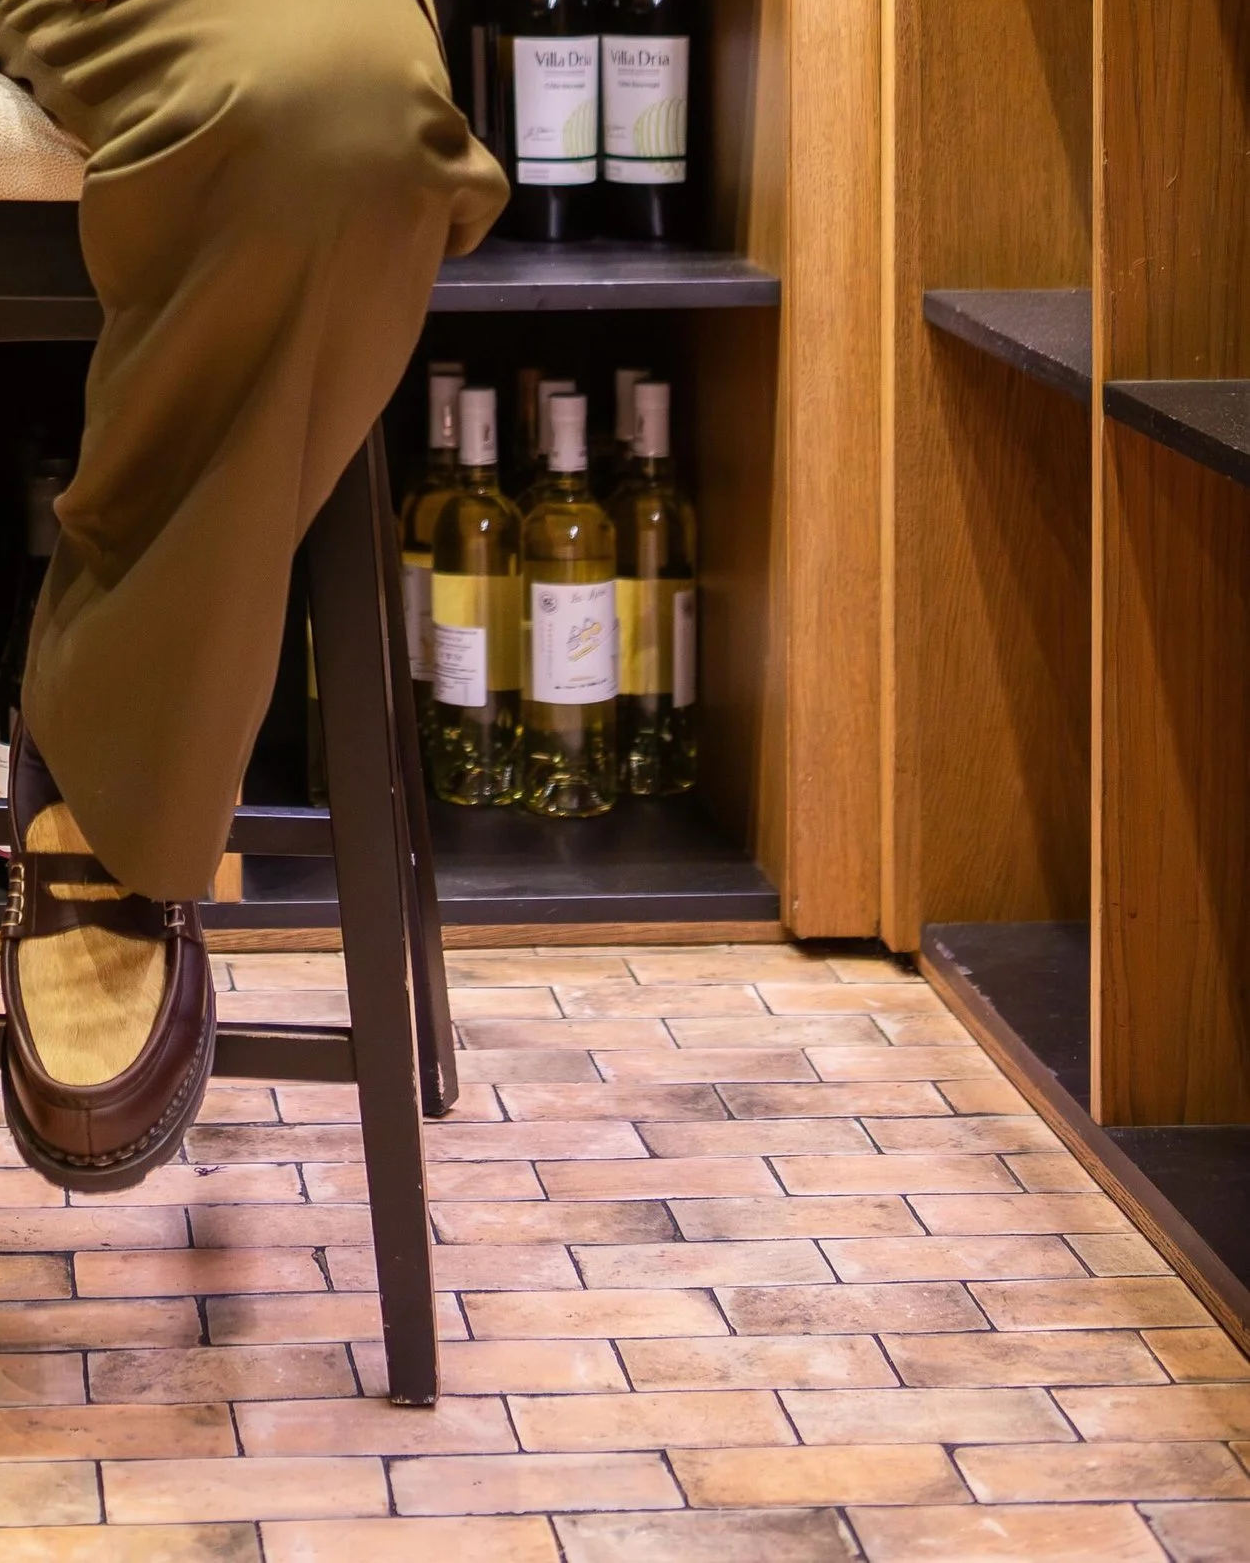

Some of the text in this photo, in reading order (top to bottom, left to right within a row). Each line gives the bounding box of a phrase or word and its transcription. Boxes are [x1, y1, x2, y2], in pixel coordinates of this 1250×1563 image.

[535, 50, 566, 68] Villa
[610, 50, 671, 67] Villa Dria
